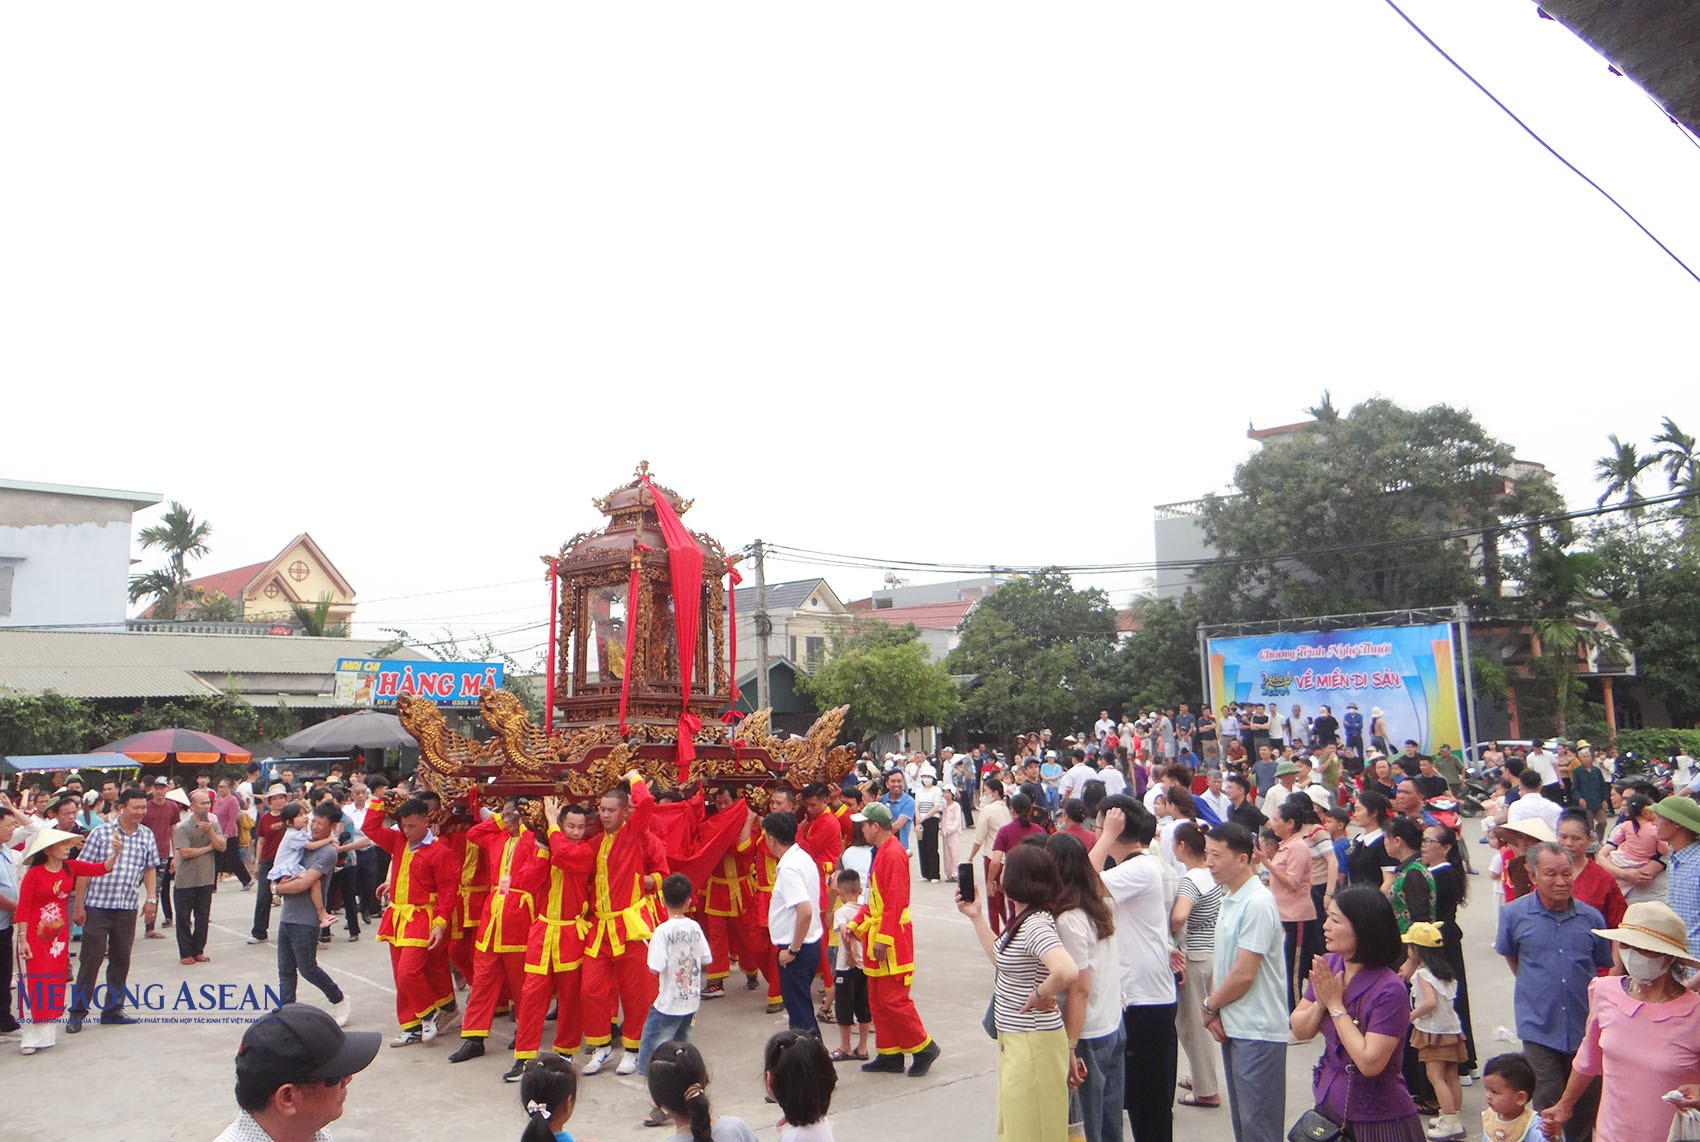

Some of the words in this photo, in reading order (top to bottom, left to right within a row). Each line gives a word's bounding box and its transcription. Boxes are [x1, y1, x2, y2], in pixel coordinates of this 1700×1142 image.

[364, 661, 380, 671] CHI
[377, 665, 453, 697] HÀNG
[1295, 668, 1314, 690] VỀ
[1316, 667, 1350, 690] MIỀN
[1351, 673, 1368, 689] DI
[1371, 667, 1400, 689] SẢN
